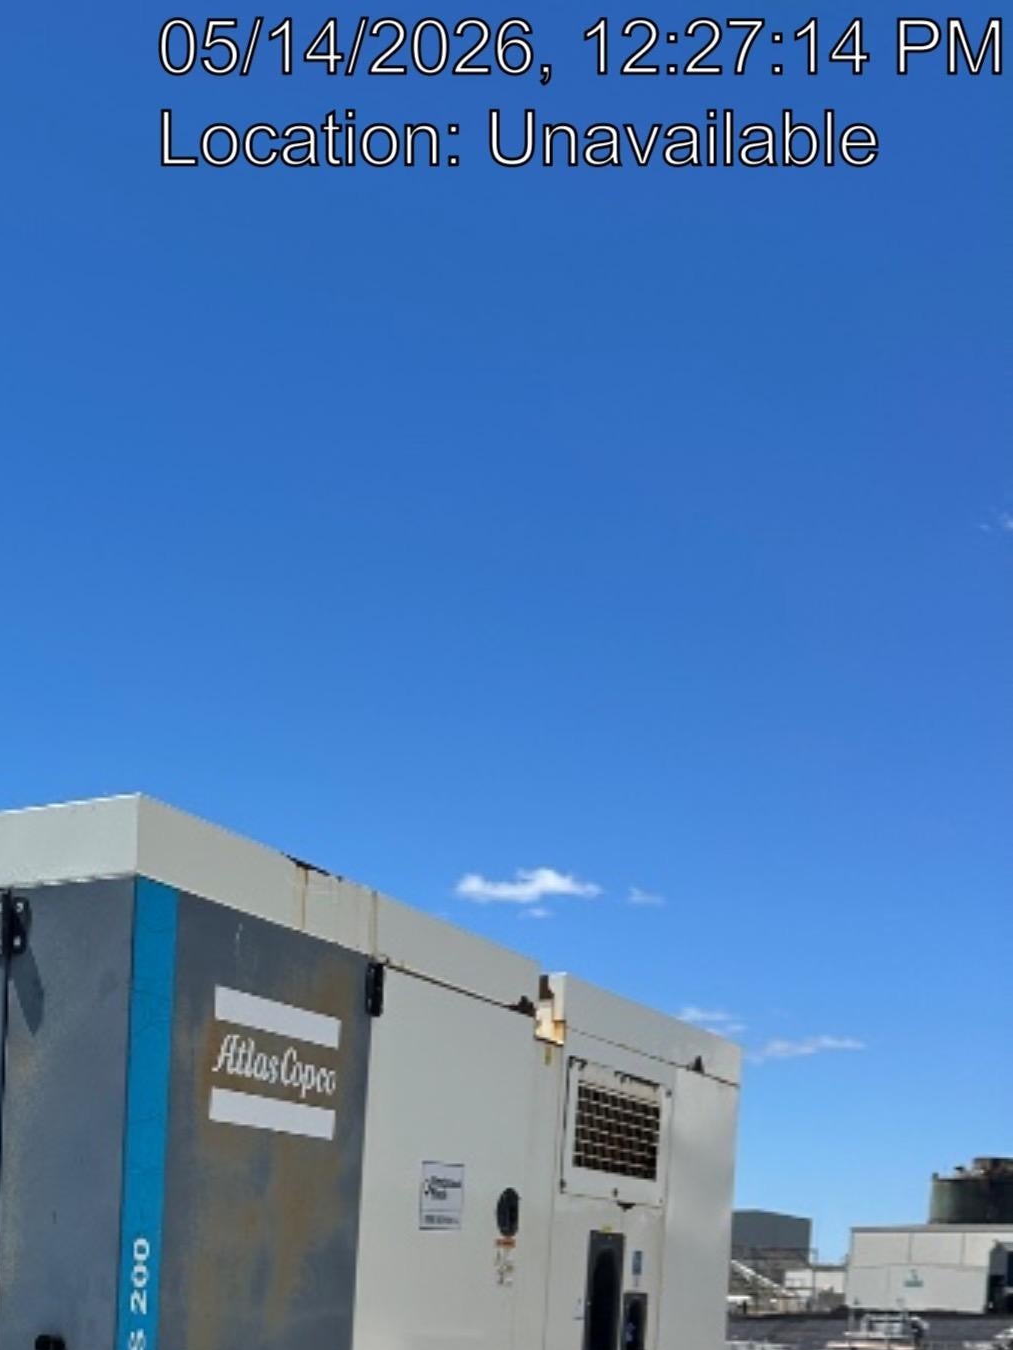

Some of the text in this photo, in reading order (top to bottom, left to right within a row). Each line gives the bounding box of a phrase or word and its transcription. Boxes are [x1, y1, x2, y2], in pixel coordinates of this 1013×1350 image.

[211, 1034, 337, 1099] Atlas Copco
[130, 1237, 150, 1315] 200
